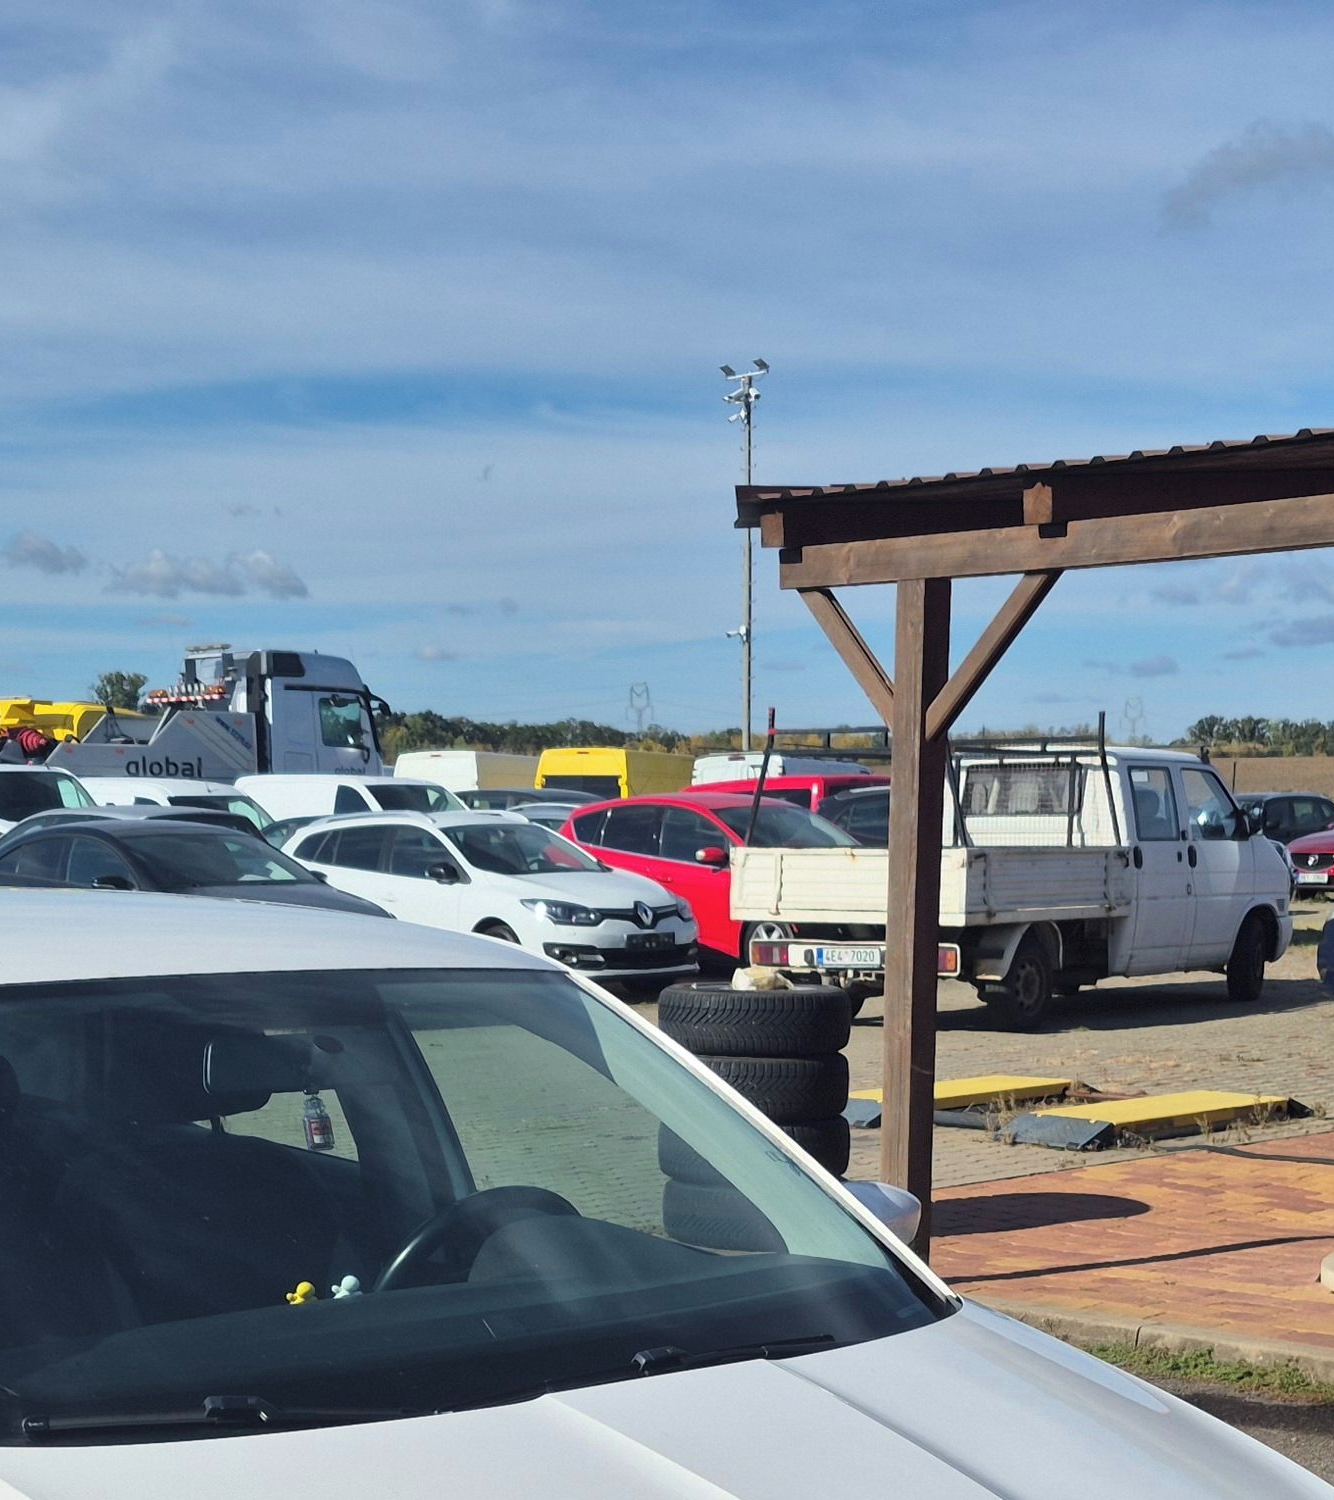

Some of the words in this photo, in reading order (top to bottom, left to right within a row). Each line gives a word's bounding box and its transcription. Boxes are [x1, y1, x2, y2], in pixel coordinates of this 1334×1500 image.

[125, 756, 203, 778] global
[825, 950, 843, 962] 4E4
[850, 950, 875, 962] 7020
